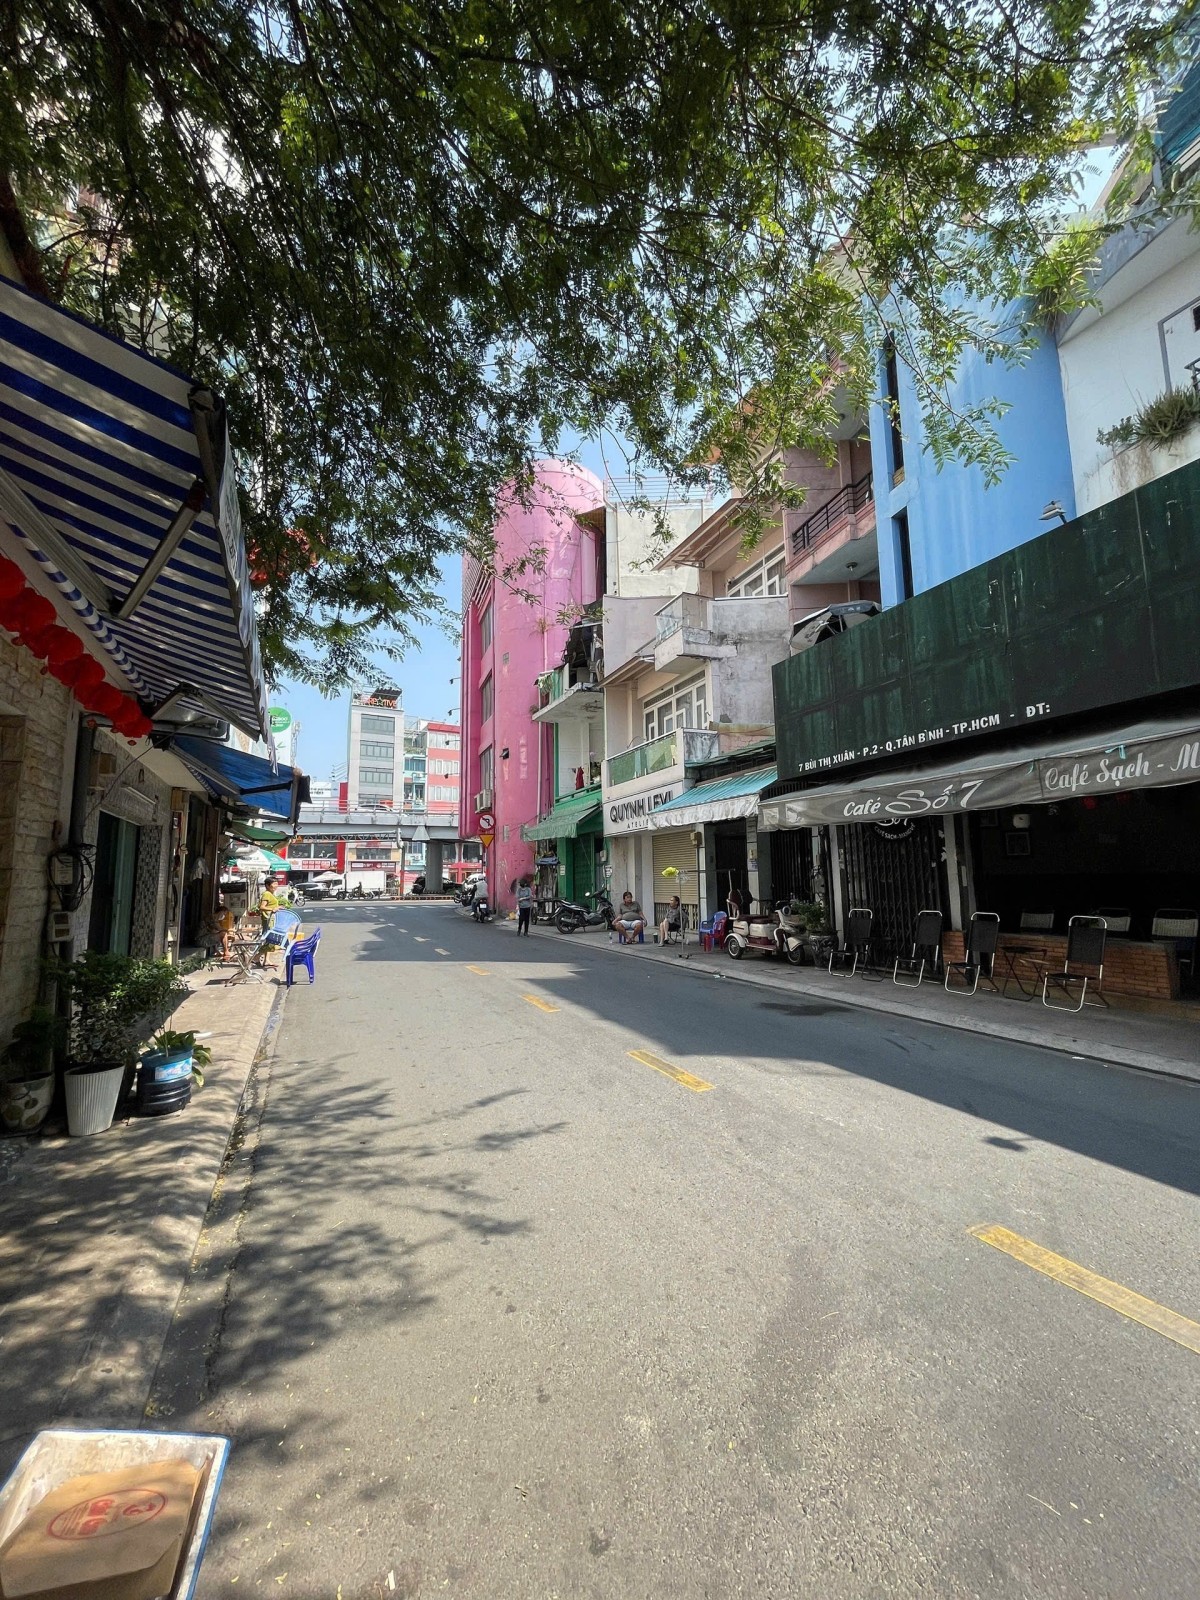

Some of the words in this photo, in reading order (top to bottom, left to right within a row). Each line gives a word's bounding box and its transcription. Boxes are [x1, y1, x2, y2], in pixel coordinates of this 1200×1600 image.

[798, 763, 804, 772] 7
[804, 758, 817, 771] BÙI
[818, 756, 832, 768] THỊ
[832, 750, 855, 765] XUÂN
[862, 745, 878, 757] P.2
[885, 734, 916, 752] Q.TÂN
[952, 713, 1000, 735] TP.HCM
[1026, 702, 1051, 718] ĐT:
[1044, 763, 1091, 792] Café
[1096, 752, 1152, 787] Sạch
[610, 798, 646, 823] QUYNH
[843, 797, 882, 817] Café
[884, 784, 954, 815] Số
[961, 779, 985, 808] 7
